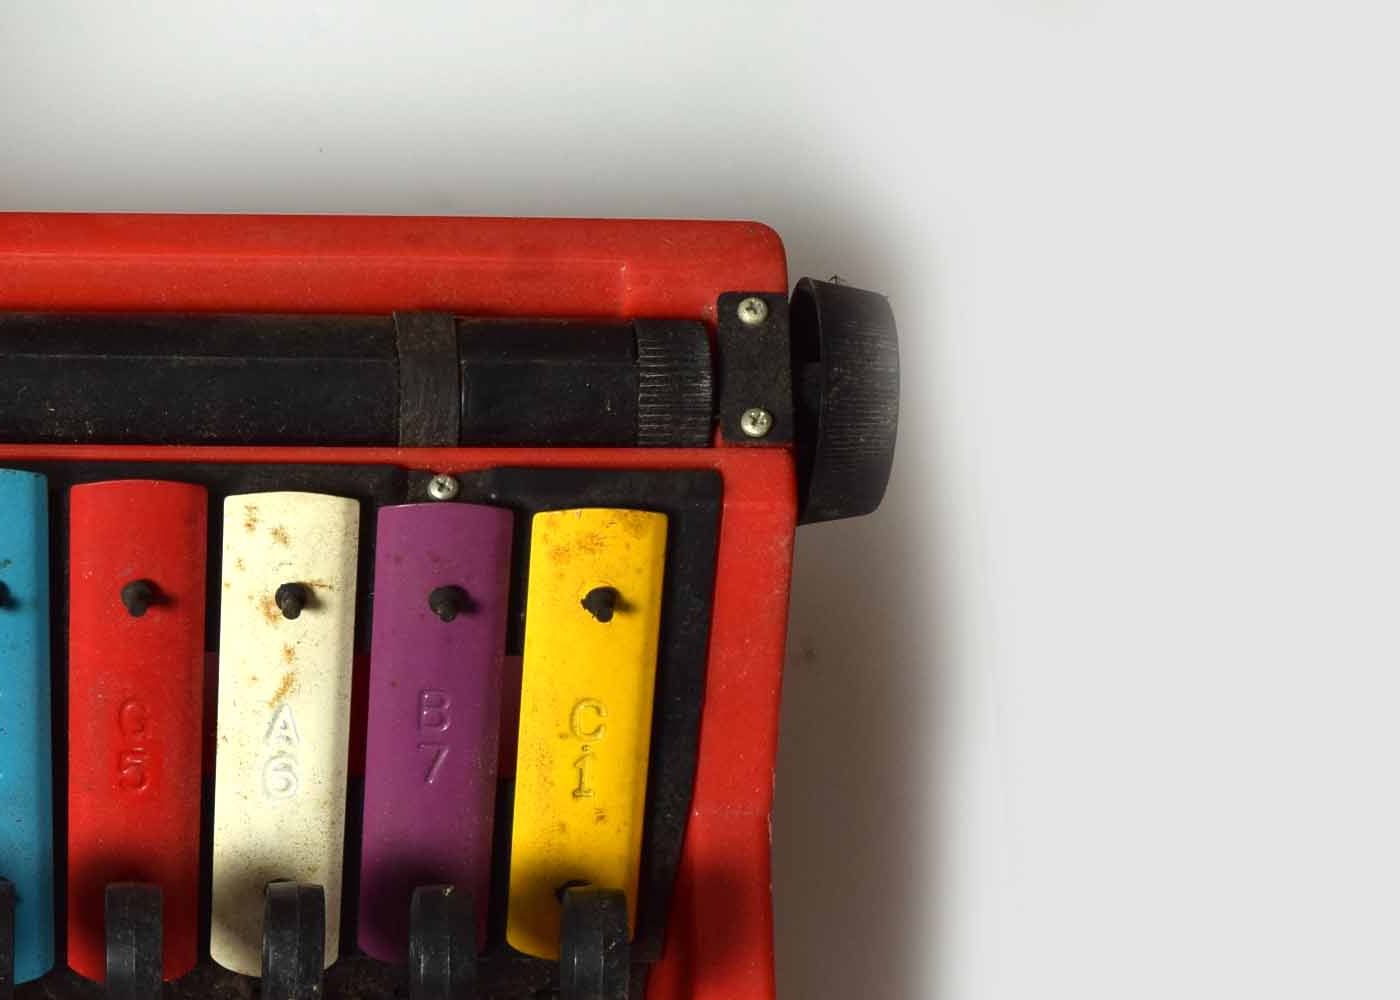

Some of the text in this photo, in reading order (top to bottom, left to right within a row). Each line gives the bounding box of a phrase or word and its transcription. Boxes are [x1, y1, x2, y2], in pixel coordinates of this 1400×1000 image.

[264, 701, 299, 745] A
[418, 689, 451, 734] B
[570, 698, 608, 742] C
[262, 752, 299, 799] 6
[418, 743, 450, 784] 7
